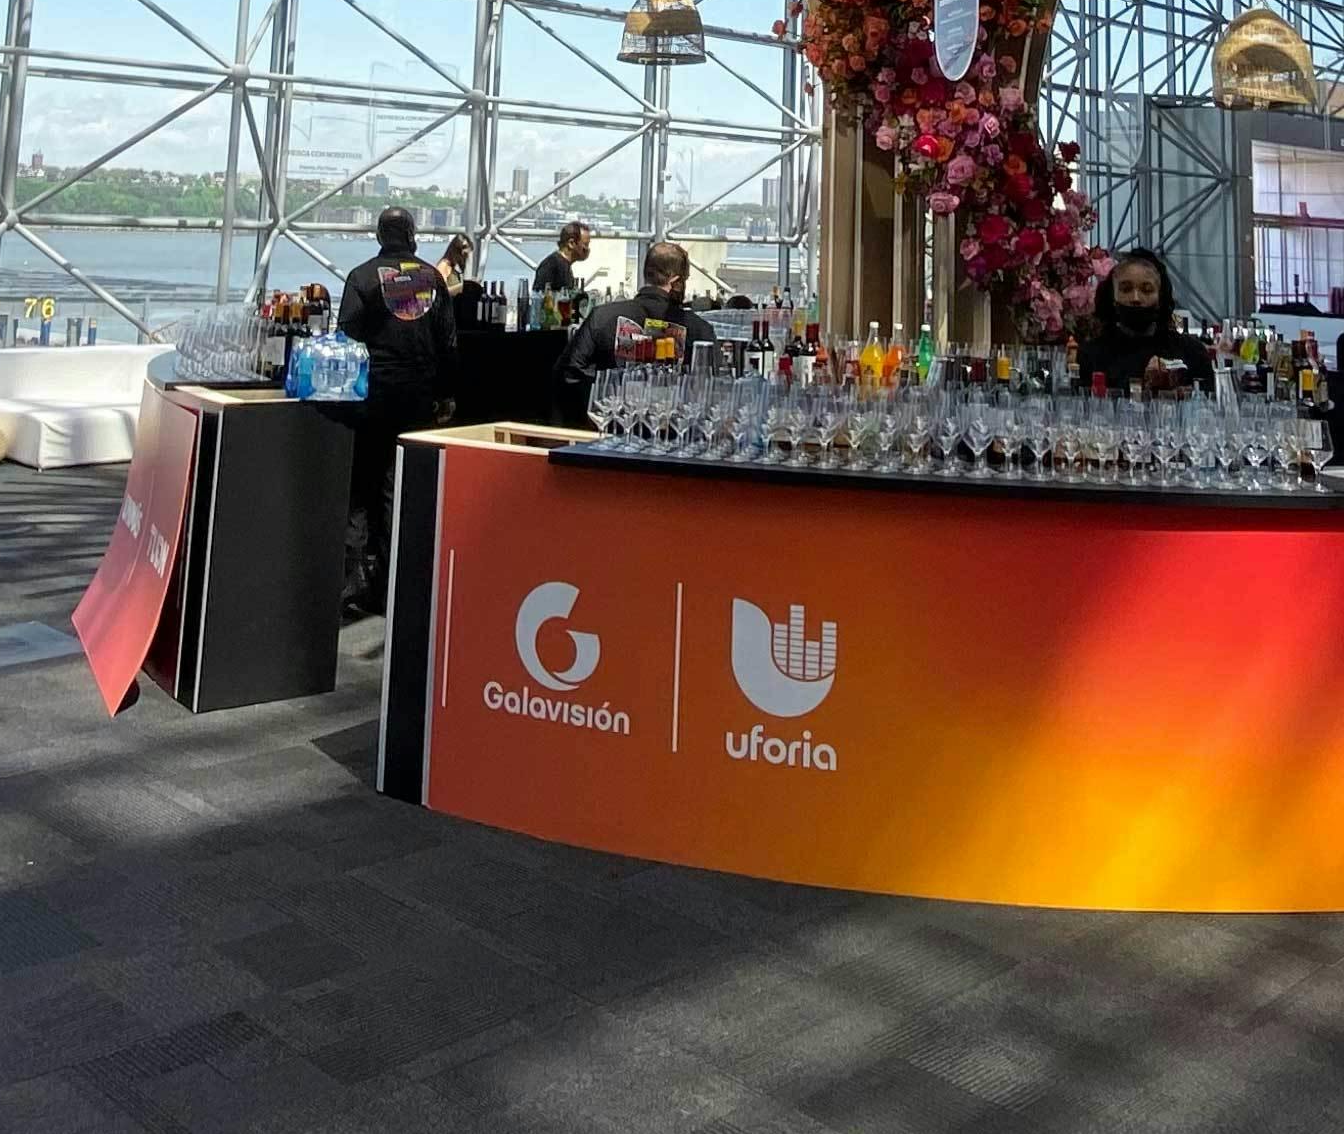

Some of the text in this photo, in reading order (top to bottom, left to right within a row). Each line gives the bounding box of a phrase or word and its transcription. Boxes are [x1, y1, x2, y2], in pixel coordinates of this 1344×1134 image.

[24, 297, 55, 319] 76
[483, 681, 631, 735] Galavisión
[724, 724, 838, 771] uforia
